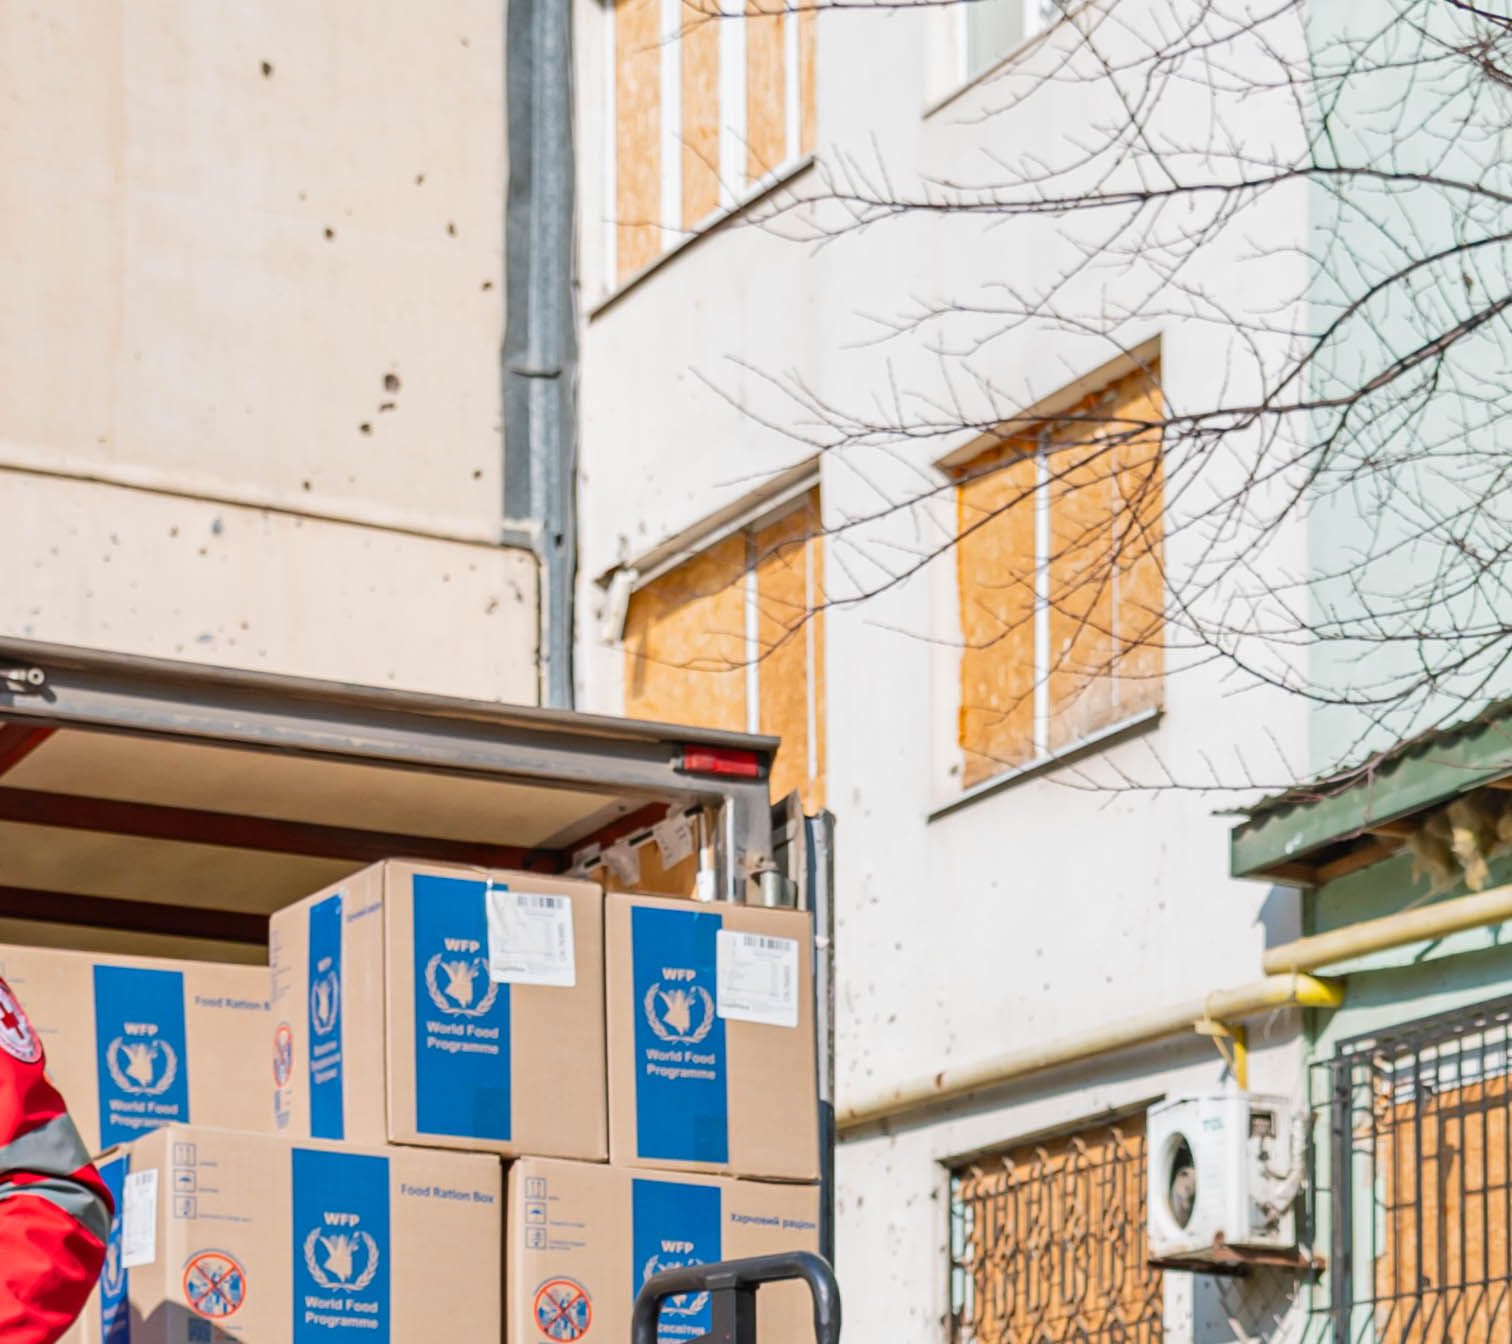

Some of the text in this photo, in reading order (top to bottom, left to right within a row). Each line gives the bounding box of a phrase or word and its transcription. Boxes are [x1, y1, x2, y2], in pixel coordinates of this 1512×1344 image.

[444, 938, 480, 953] WFP
[662, 967, 696, 981] WFP
[124, 1022, 158, 1037] WFP
[426, 1021, 499, 1039] World Food
[426, 1036, 499, 1055] Programme
[646, 1049, 715, 1064] World Food
[647, 1064, 715, 1080] Programme
[110, 1100, 178, 1116] World Food
[400, 1183, 495, 1204] Food Ration Box
[324, 1212, 360, 1226] WFP
[661, 1240, 694, 1254] WFP
[305, 1296, 378, 1313] World Food
[305, 1312, 378, 1330] Programme
